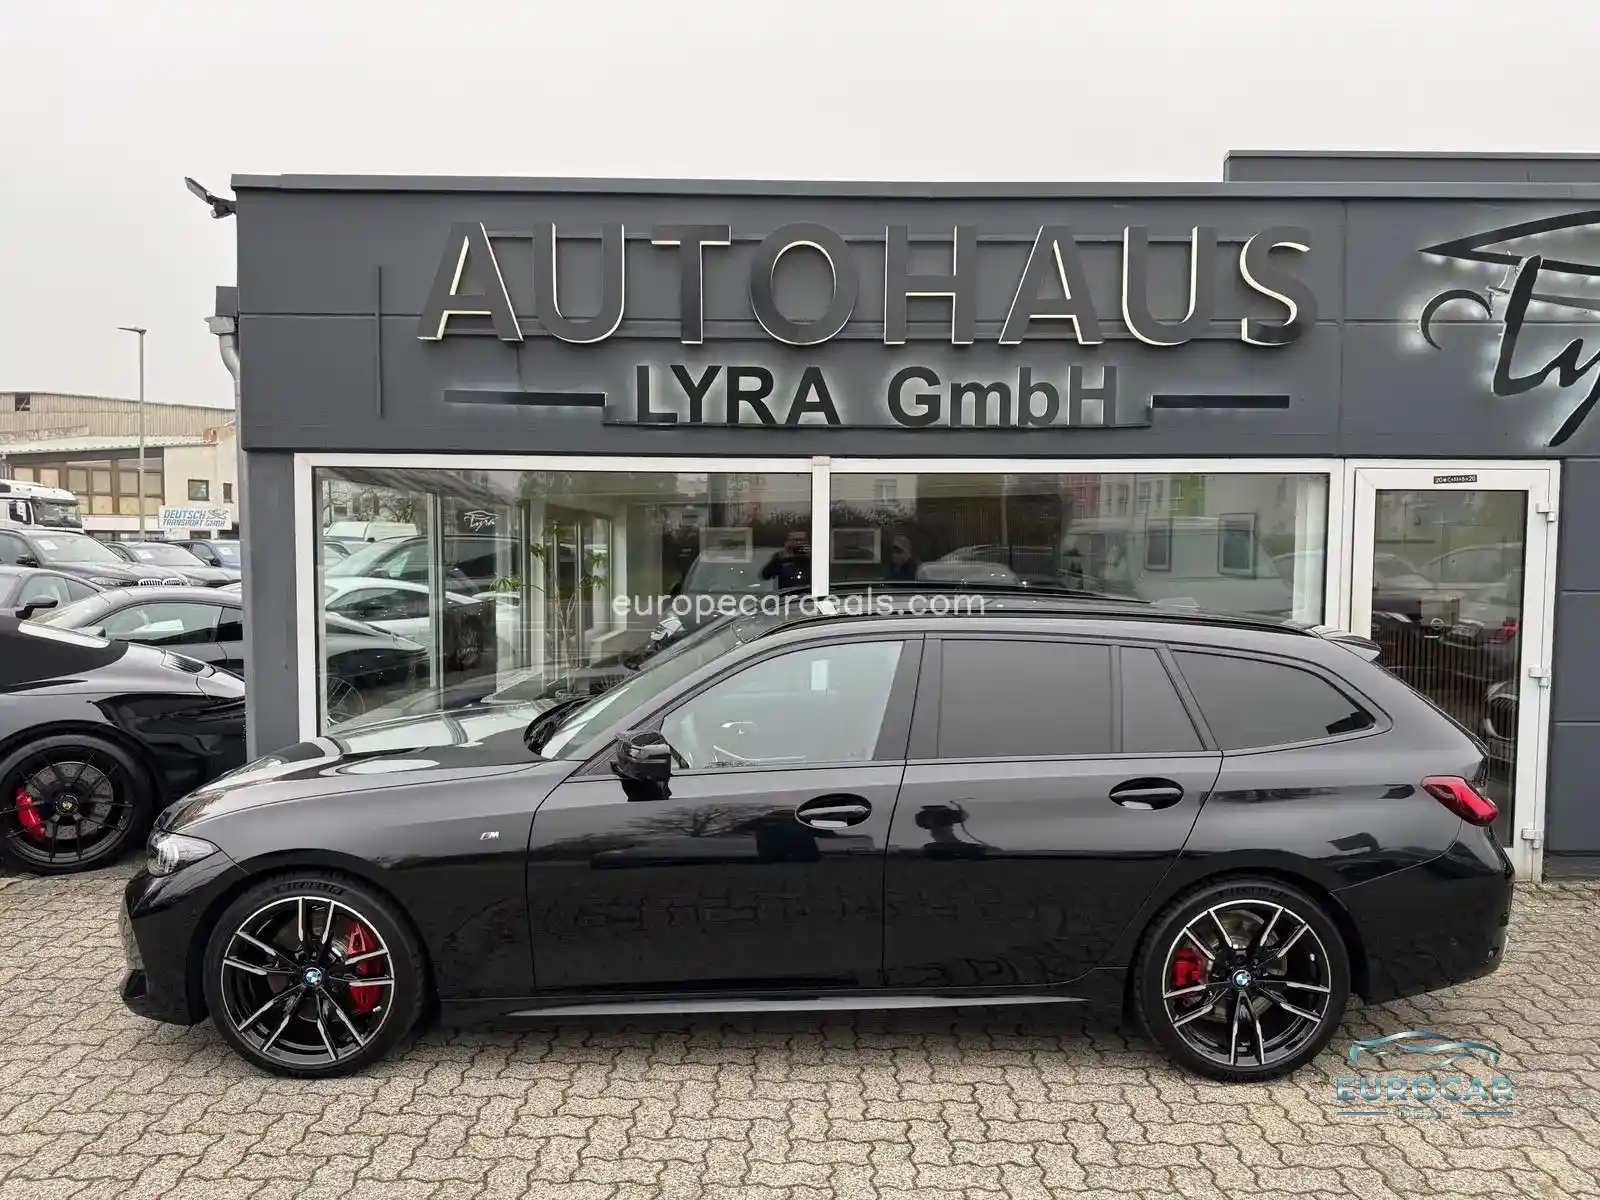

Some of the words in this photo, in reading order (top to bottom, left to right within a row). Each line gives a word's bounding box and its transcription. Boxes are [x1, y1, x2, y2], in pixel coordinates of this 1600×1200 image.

[417, 222, 1318, 347] AUTOHAUS
[636, 365, 841, 427] LYRA
[887, 365, 1118, 427] GmbH
[163, 509, 206, 519] DEUTSCH
[163, 519, 203, 527] TRANSPORT
